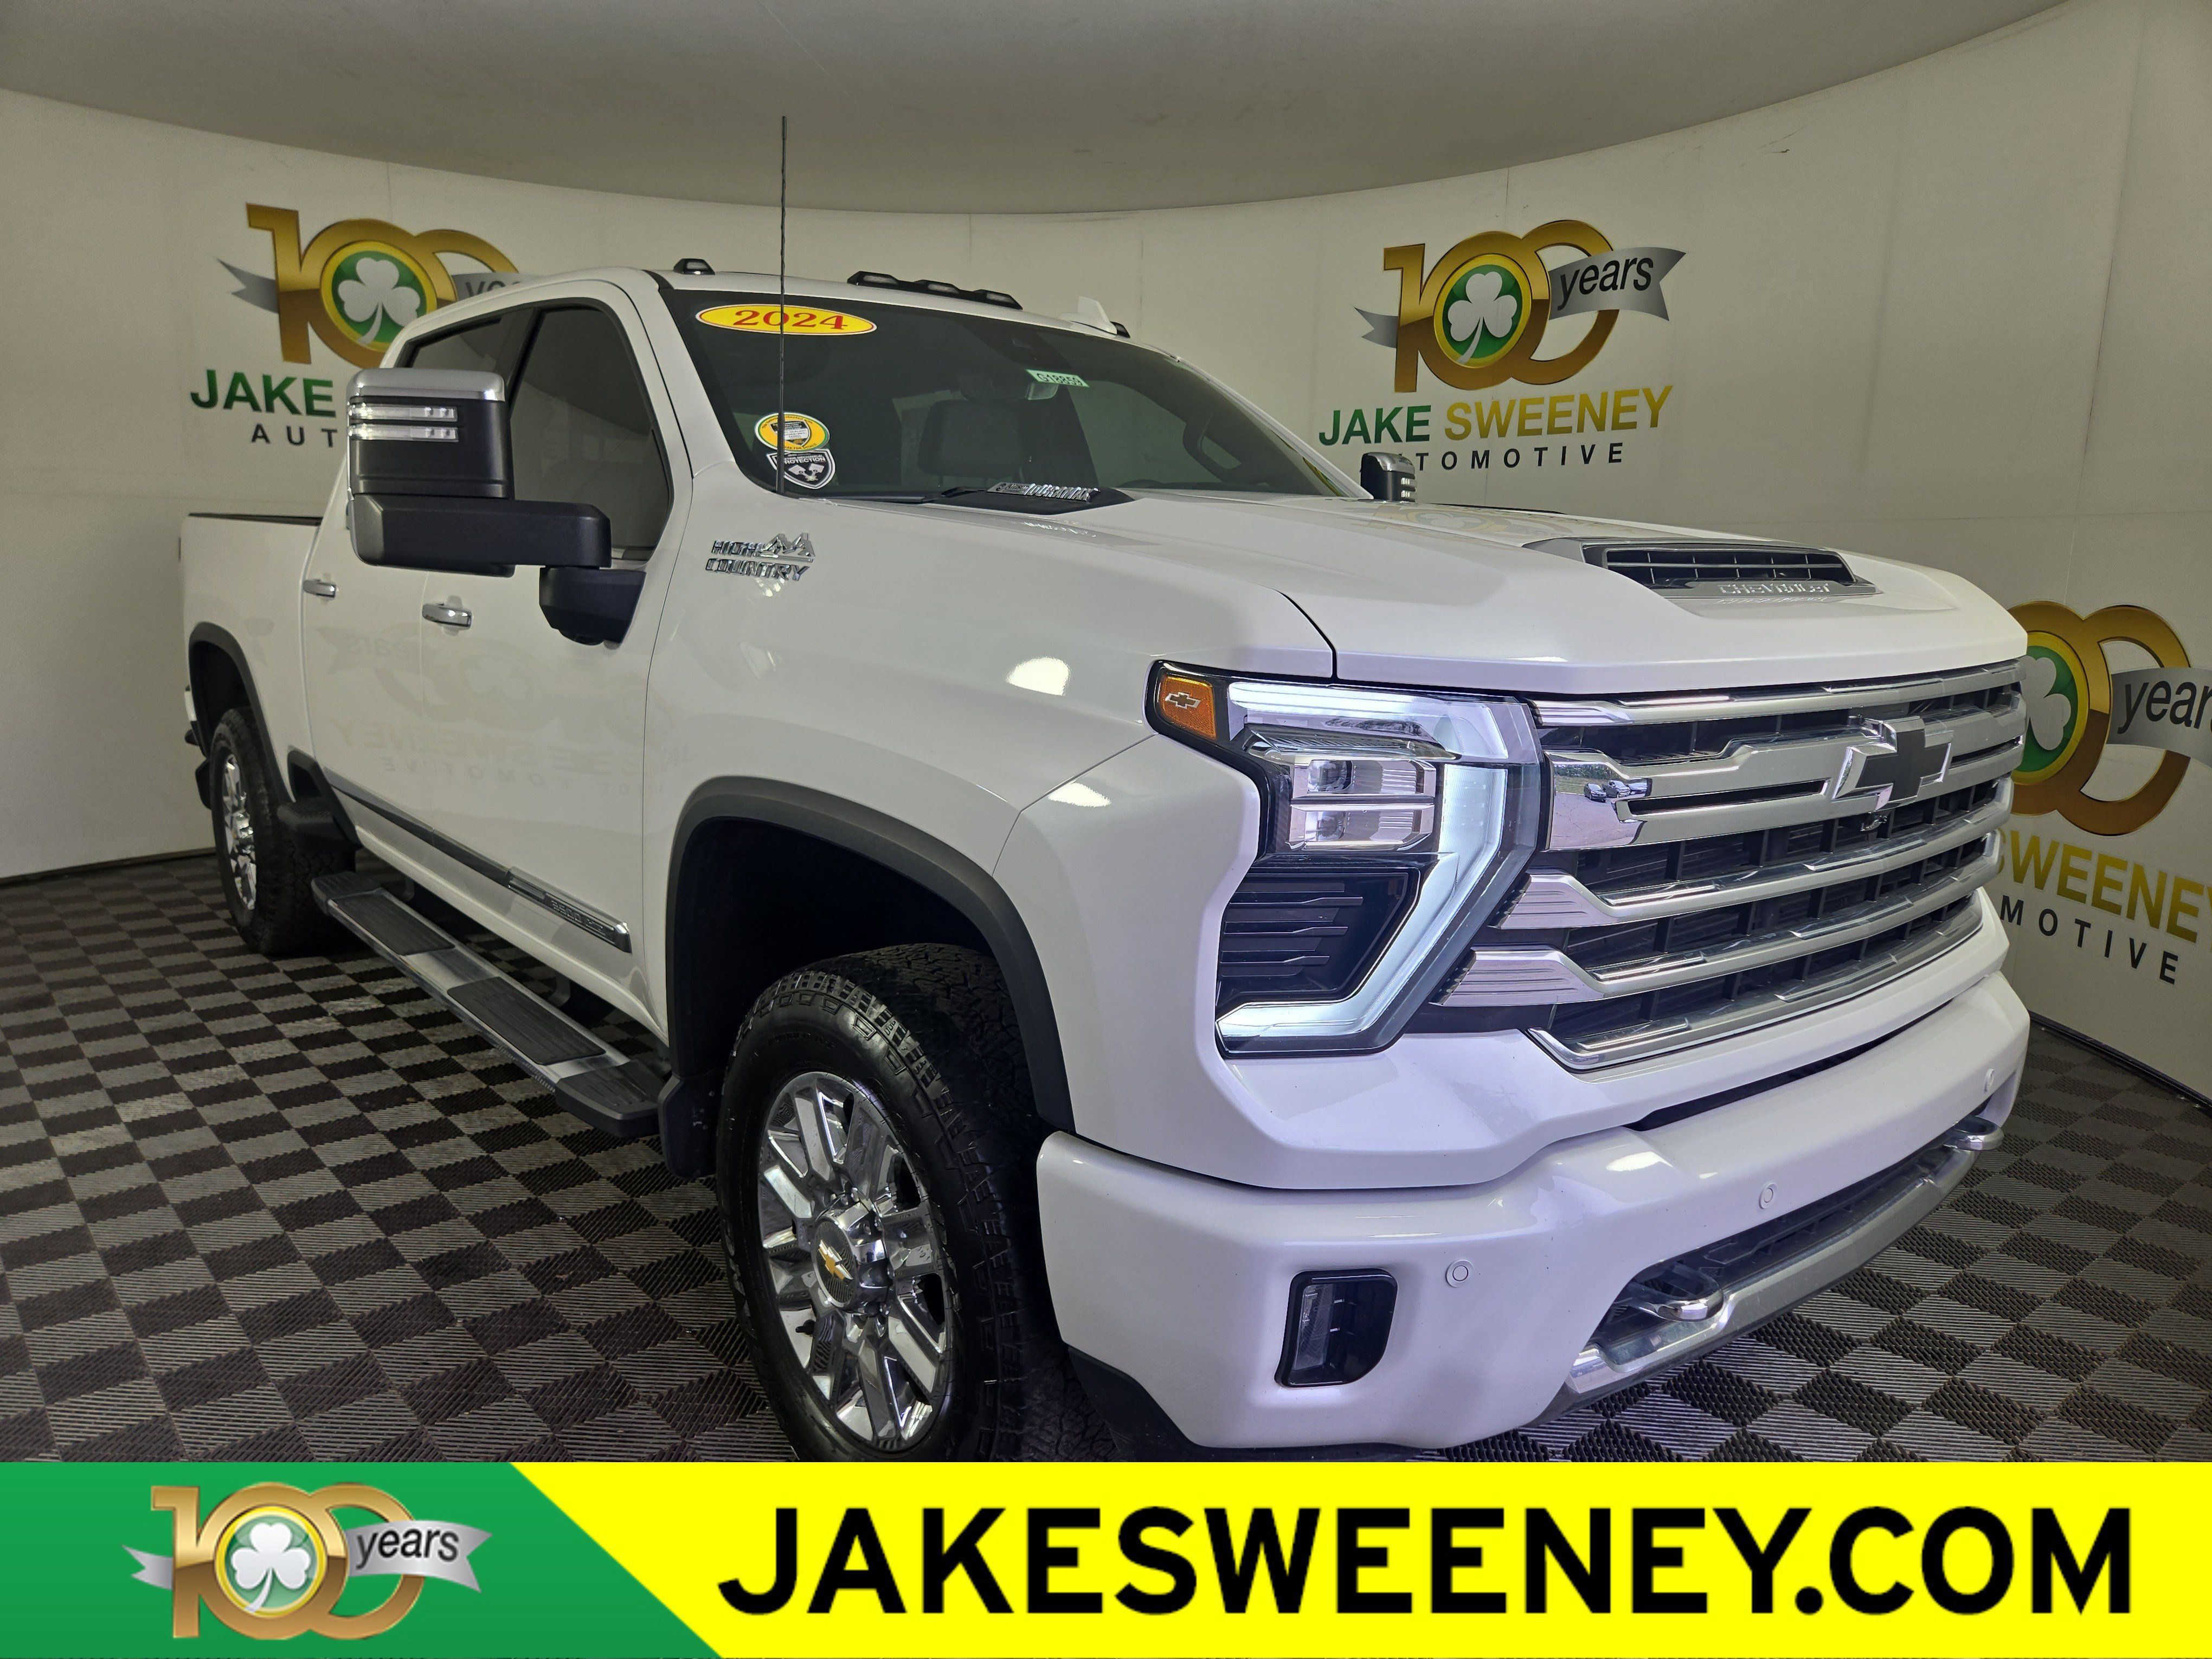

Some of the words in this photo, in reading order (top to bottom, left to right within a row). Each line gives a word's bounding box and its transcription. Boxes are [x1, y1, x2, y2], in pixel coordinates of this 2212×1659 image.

[1383, 219, 1620, 393] 100
[1557, 256, 1654, 311] years
[732, 310, 848, 330] 2024
[190, 369, 337, 418] JAKE
[1319, 405, 1431, 446] JAKE
[1444, 385, 1674, 441] SWEENEY
[784, 456, 826, 465] ROTECTION
[1415, 442, 1623, 472] TOMOTIVE
[705, 558, 811, 582] COUNTRY
[2006, 600, 2191, 837] 00
[2117, 677, 2212, 735] year
[1997, 829, 2212, 953] WEENE
[2000, 895, 2179, 985] MOTIVE
